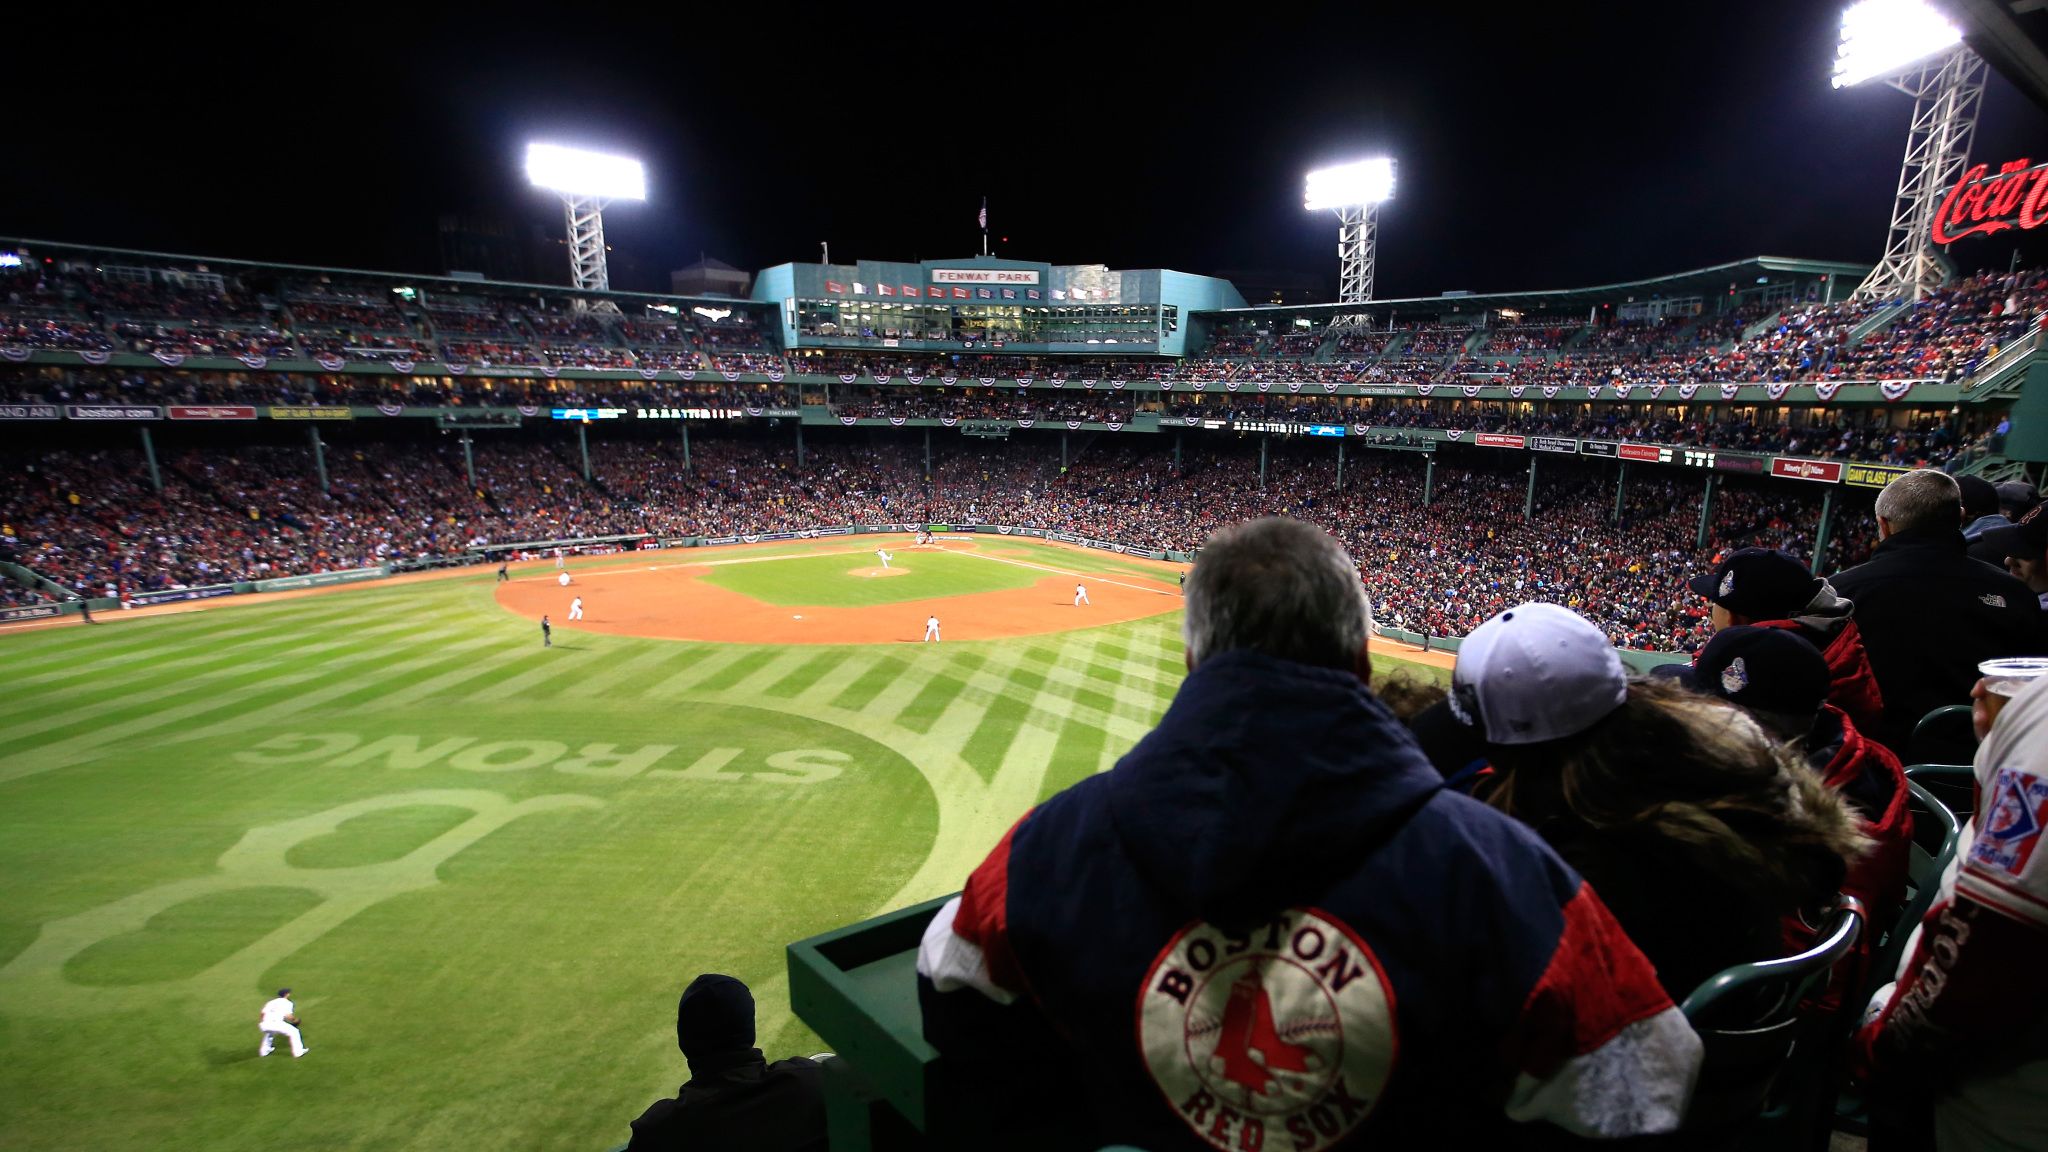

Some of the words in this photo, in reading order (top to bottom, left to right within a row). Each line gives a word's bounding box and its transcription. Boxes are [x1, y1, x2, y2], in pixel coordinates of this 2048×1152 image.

[939, 272, 990, 281] FENWAY
[997, 273, 1032, 282] PARK
[1849, 469, 1867, 481] GIANT
[1866, 470, 1888, 484] GLASS
[232, 732, 855, 784] STRONG
[1182, 1087, 1264, 1152] RED
[1286, 1076, 1368, 1151] SOX
